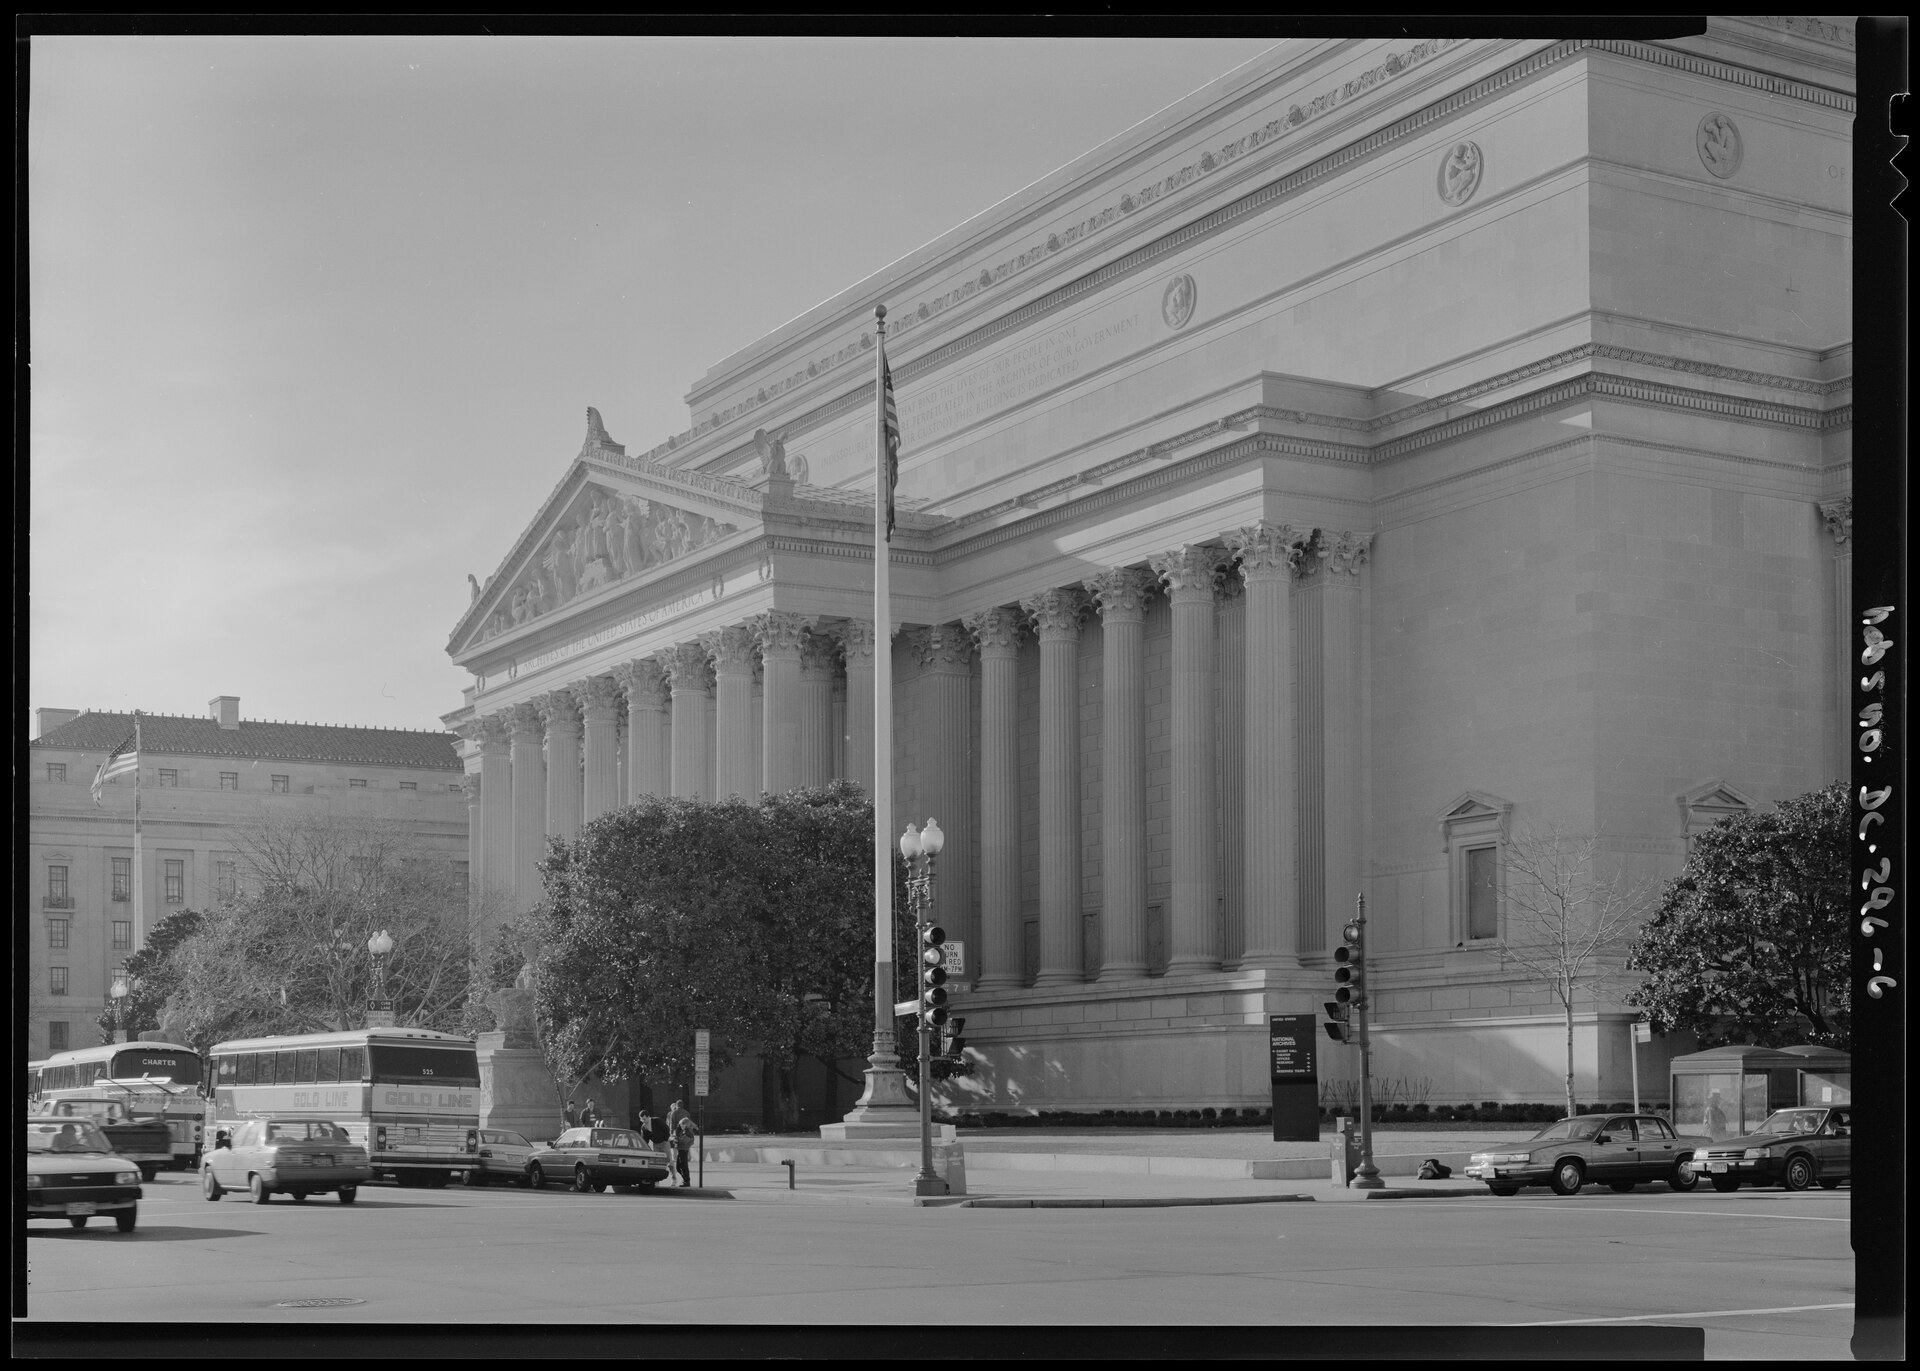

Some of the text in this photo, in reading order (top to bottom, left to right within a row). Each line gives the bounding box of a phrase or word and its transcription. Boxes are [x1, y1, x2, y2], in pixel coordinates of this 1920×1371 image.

[898, 402, 916, 418] THAT
[918, 391, 937, 408] BIND
[939, 383, 954, 399] THE
[957, 374, 978, 392] LIVES
[979, 366, 990, 380] OF
[992, 358, 1010, 375] OUR
[1013, 342, 1043, 363] PEOPLE
[1045, 337, 1056, 350] IN
[1057, 325, 1078, 344] ONE
[912, 395, 963, 426] PERPETUATED
[966, 390, 975, 403] IN
[978, 382, 993, 395] THE
[996, 361, 1038, 388] ARCHIVES
[1039, 355, 1051, 370] OF
[1053, 346, 1073, 362] OUR
[1075, 314, 1140, 353] GOVERNMENT
[917, 417, 953, 440] CUSTODY
[955, 407, 974, 424] THIS
[976, 390, 1016, 415] BUILDING
[1018, 381, 1026, 395] IS
[1028, 359, 1080, 391] DEDICATED
[523, 648, 559, 671] ARCHIVES
[573, 635, 586, 652] THE
[588, 626, 616, 646] UNITED
[618, 613, 648, 635] STATES
[661, 590, 703, 616] AMERICA
[142, 1058, 177, 1067] CHARTER
[294, 1091, 349, 1107] GOLD LINE
[385, 1091, 473, 1108] GOLD LINE
